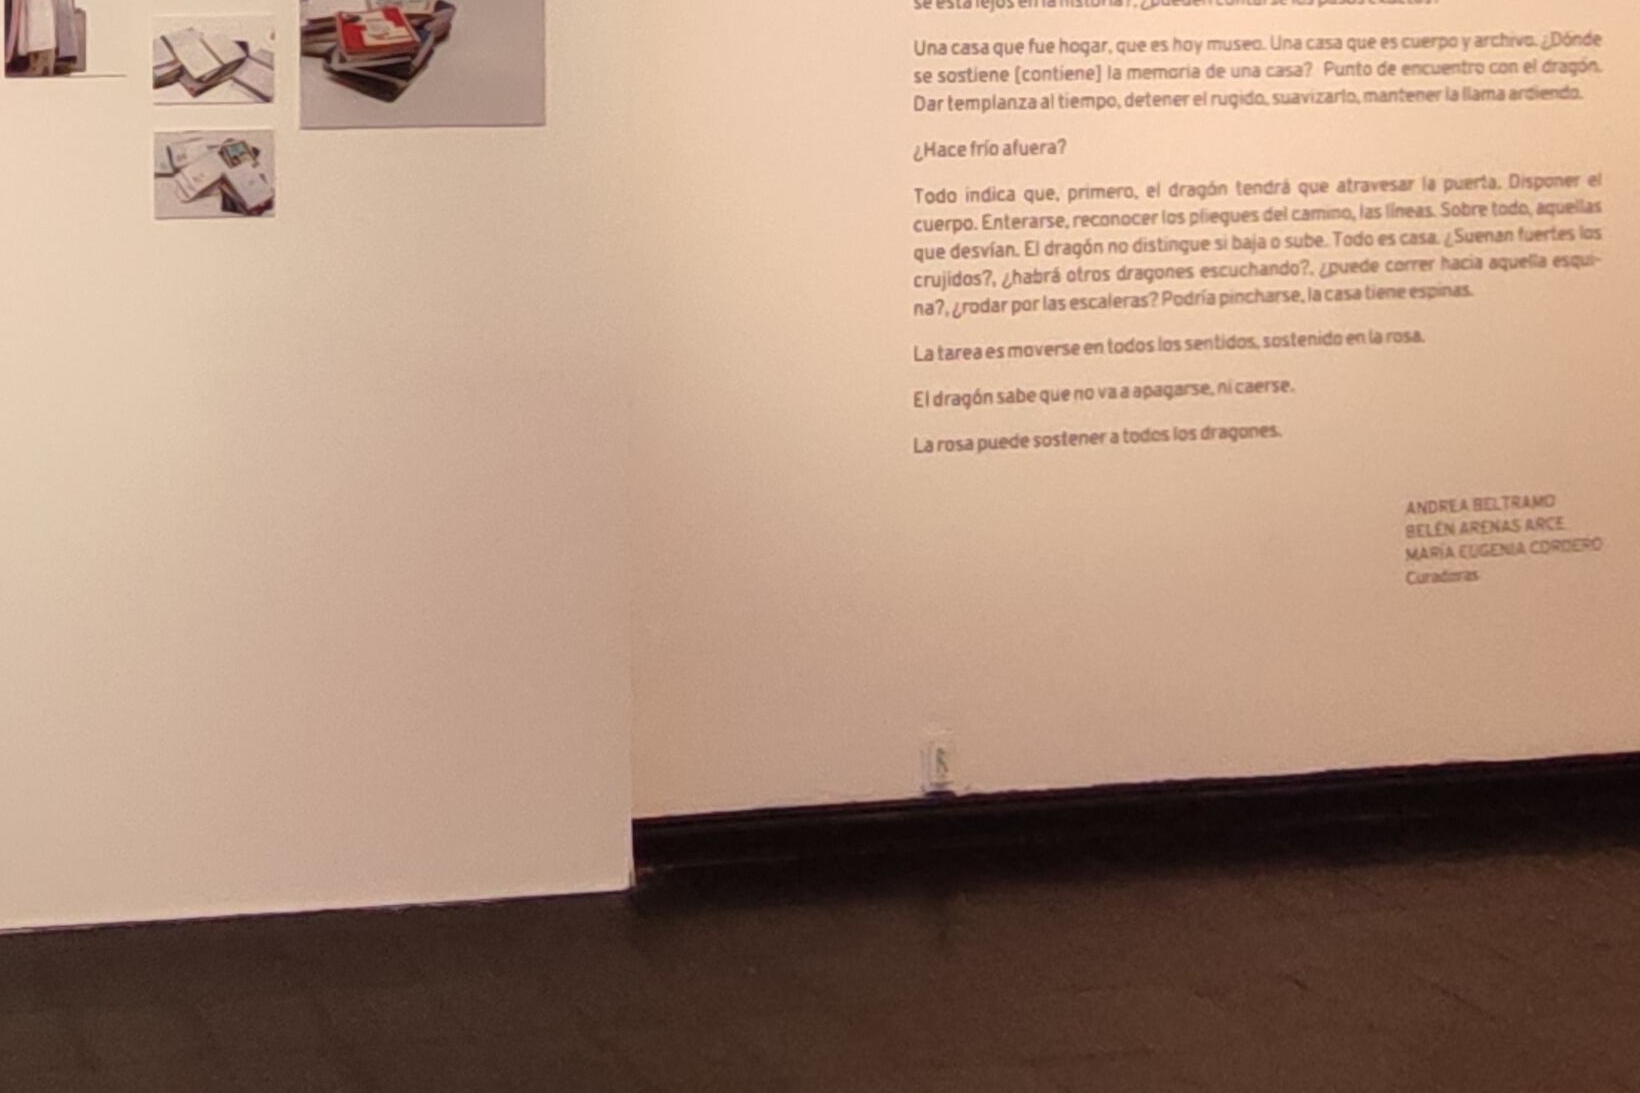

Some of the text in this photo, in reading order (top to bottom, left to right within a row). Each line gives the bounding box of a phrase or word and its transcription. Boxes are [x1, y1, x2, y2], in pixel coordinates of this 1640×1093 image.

[914, 35, 1302, 58] Una casa que fue que es hoy Una
[914, 60, 1372, 85] se sostiene [contiene] la memoria de una Punto
[914, 94, 943, 112] Dar
[948, 94, 1037, 114] templanza
[1040, 93, 1054, 110] al
[1124, 91, 1189, 108] detener
[1193, 91, 1207, 107] el
[913, 138, 1066, 162] ¿Hace frío afuera?
[915, 187, 957, 205] Todo
[966, 186, 1015, 204] indica
[1146, 182, 1160, 198] el
[1168, 180, 1228, 200] dragón
[1236, 178, 1291, 196] tendrá
[1298, 181, 1329, 198] que
[1073, 212, 1158, 228] reconocer
[1162, 209, 1185, 225] los
[1189, 207, 1259, 228] pliegues
[1441, 201, 1488, 218] Sobre
[914, 246, 946, 264] que
[1025, 239, 1040, 257] El
[1044, 237, 1104, 260] dragón
[1108, 240, 1128, 255] no
[1132, 236, 1211, 256] distingue
[1214, 238, 1228, 251] si
[1232, 234, 1267, 255] baja
[1334, 230, 1374, 247] Todo
[1001, 266, 1061, 289] ¿habrá
[1066, 265, 1110, 284] otros
[1116, 265, 1194, 285] dragones
[951, 297, 1008, 320] ¿rodar
[1011, 298, 1039, 316] por
[1043, 295, 1066, 312] las
[1069, 291, 1159, 311] escaleras?
[1162, 288, 1216, 307] Podría
[914, 336, 1182, 362] La tarea es moverse en todos los
[914, 390, 929, 409] El
[933, 388, 993, 410] dragón
[997, 388, 1037, 405] sabe
[1039, 388, 1071, 405] que
[1074, 387, 1094, 401] no
[1098, 387, 1117, 400] va
[1120, 385, 1130, 400] a
[1217, 381, 1232, 394] ni
[914, 437, 934, 454] La
[937, 437, 974, 453] rosa
[977, 433, 1030, 454] puede
[1033, 431, 1106, 449] sostener
[1110, 431, 1119, 445] a
[1123, 427, 1170, 444] todos
[1173, 426, 1197, 442] los
[1406, 498, 1469, 516] ANDREA
